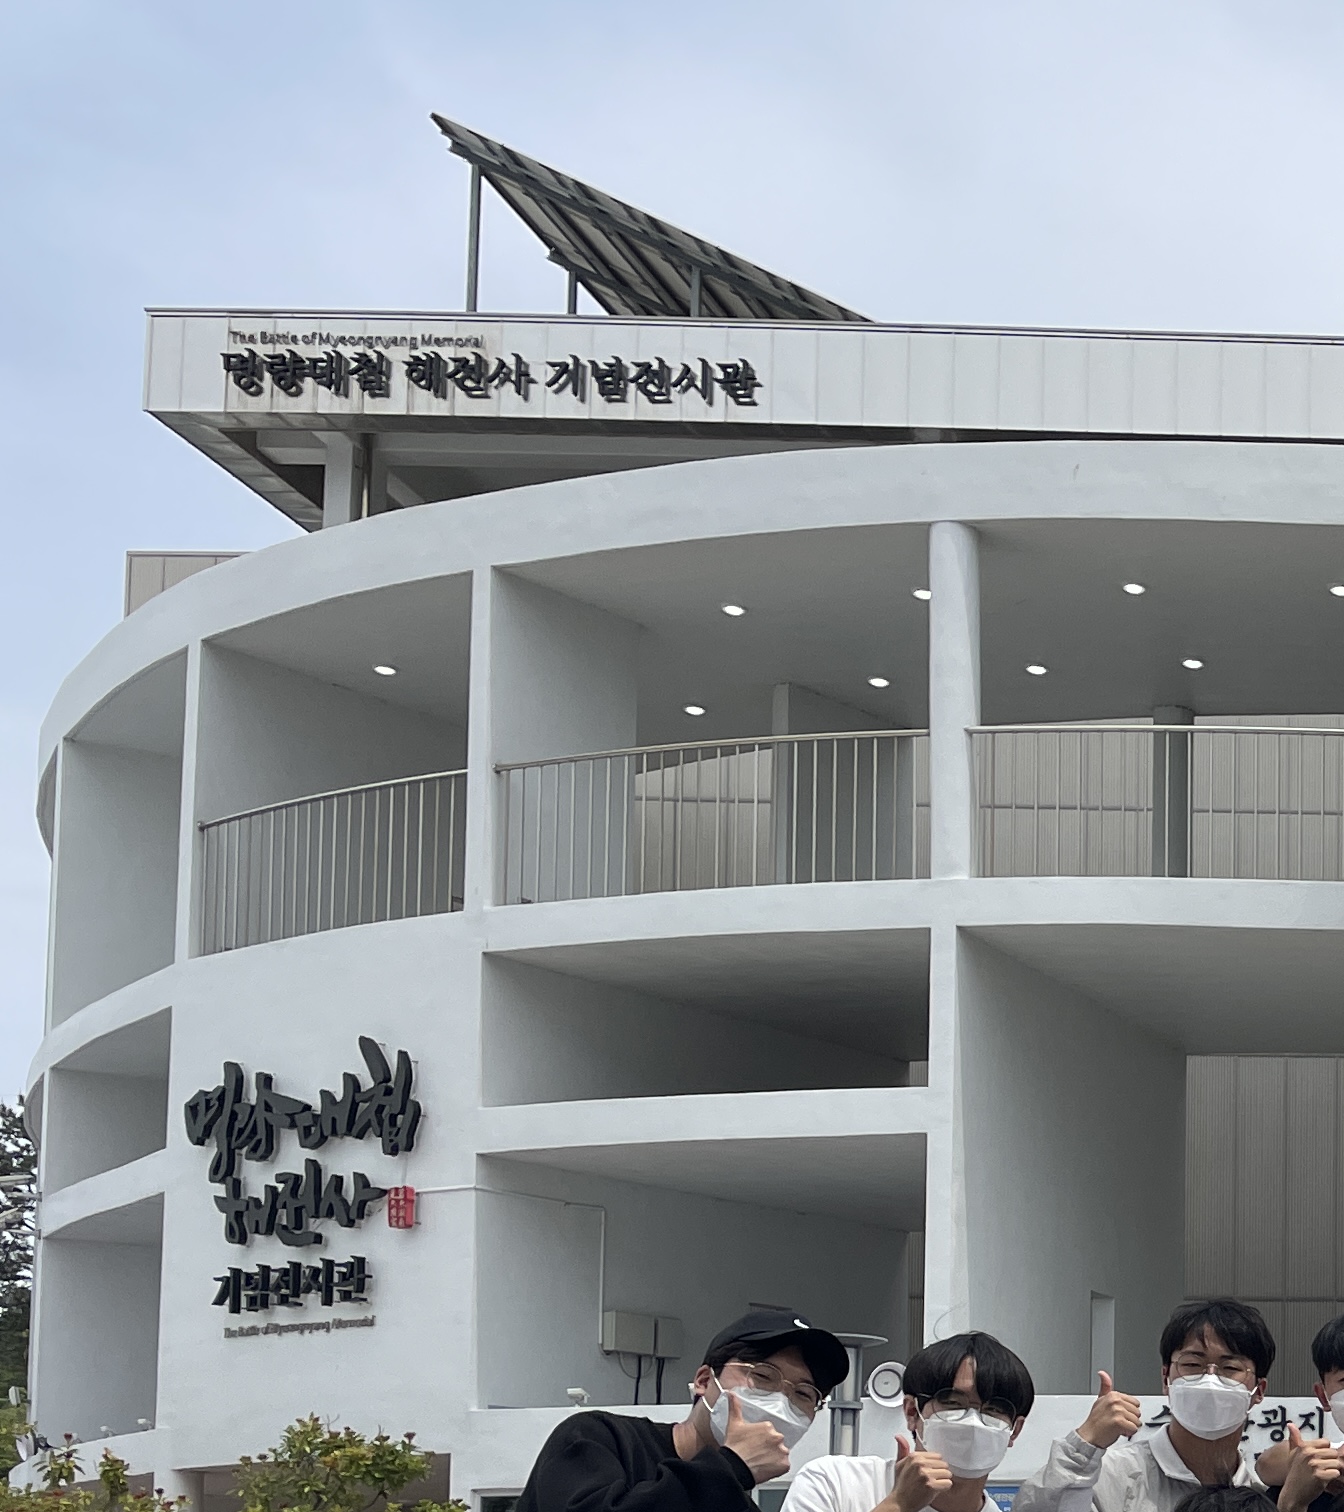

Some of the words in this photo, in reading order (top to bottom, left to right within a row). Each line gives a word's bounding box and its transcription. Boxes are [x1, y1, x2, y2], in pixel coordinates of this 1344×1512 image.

[220, 347, 391, 399] 명량대첩
[402, 350, 538, 402] 해전사
[545, 353, 764, 407] 기념전시관
